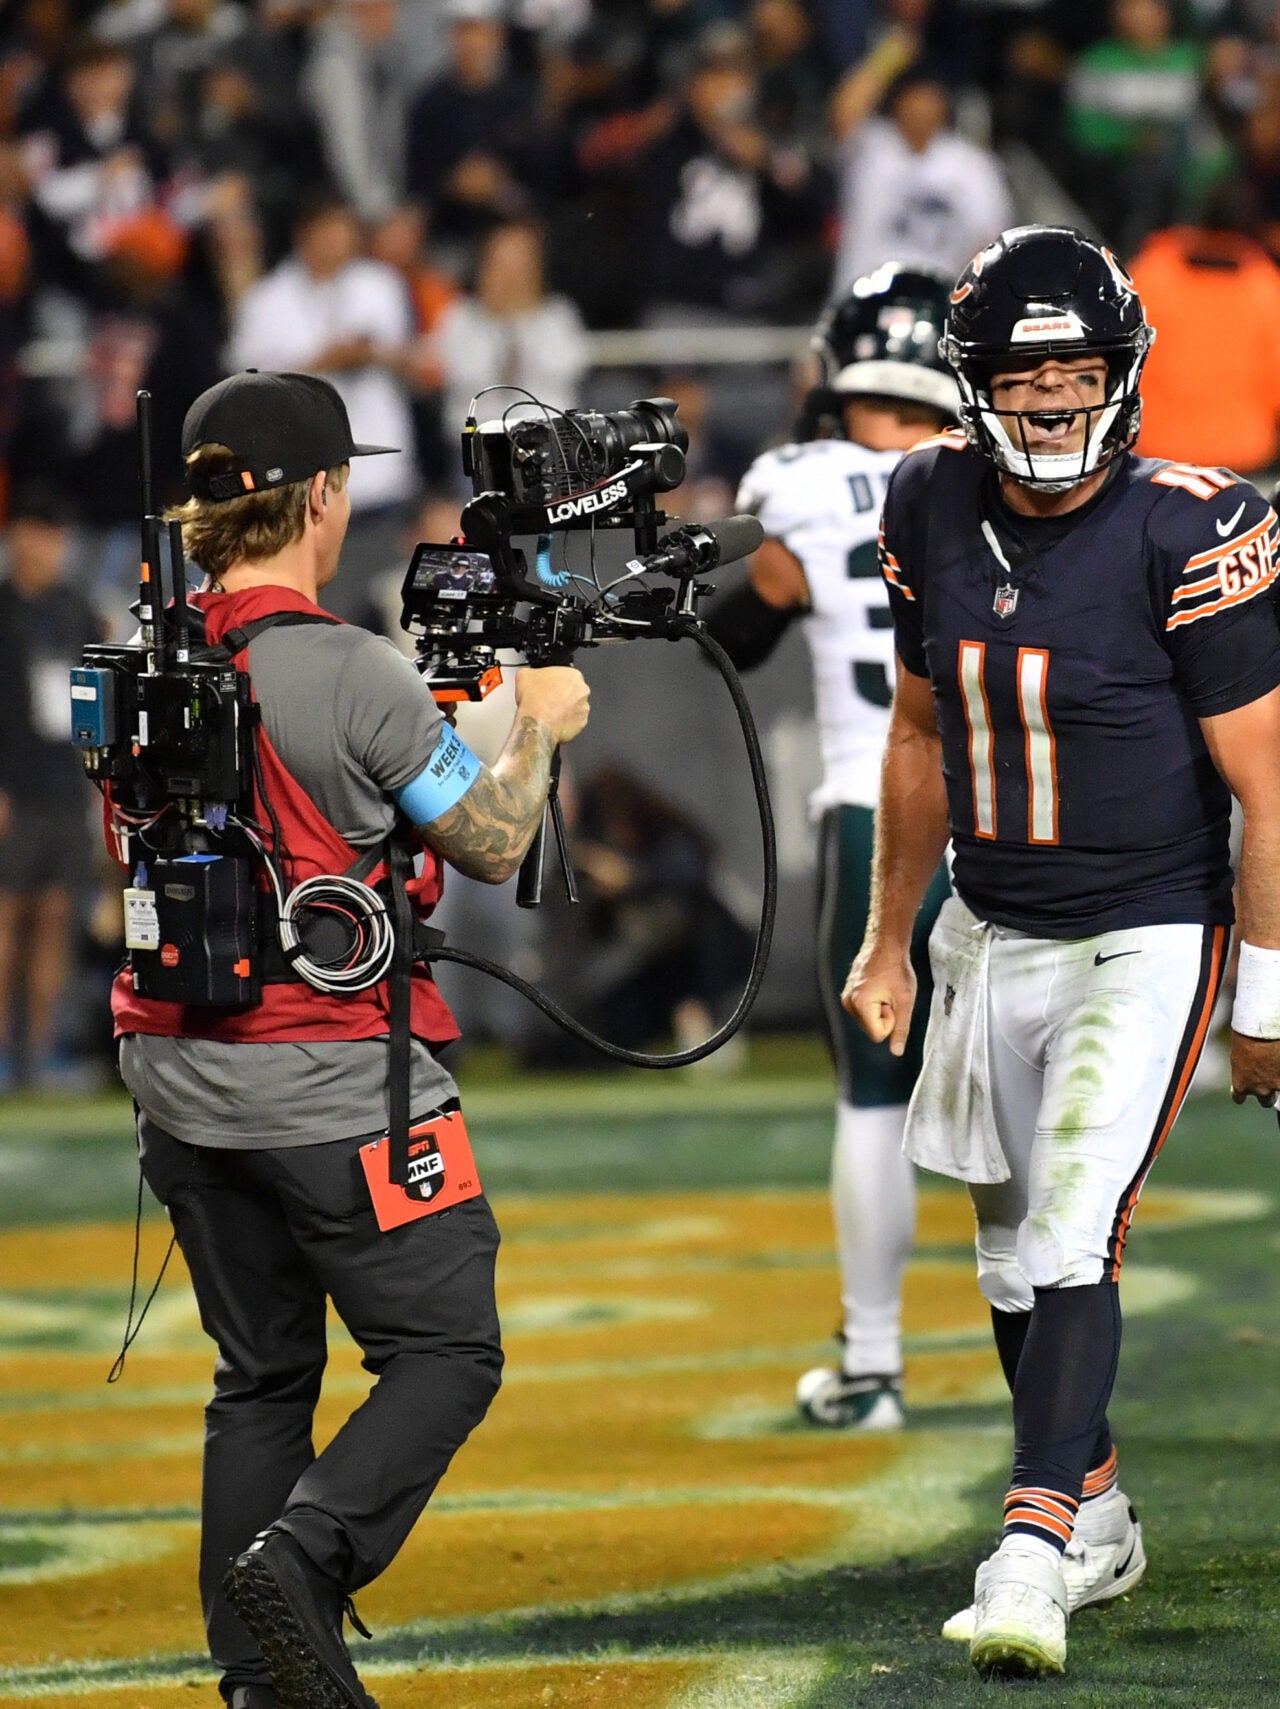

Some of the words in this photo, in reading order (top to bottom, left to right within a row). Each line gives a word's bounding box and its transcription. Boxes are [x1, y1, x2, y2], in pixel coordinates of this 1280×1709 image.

[1022, 321, 1071, 333] BEARS
[546, 480, 628, 525] LOVELESS
[1150, 463, 1238, 502] 11
[1217, 531, 1273, 597] GSH
[430, 740, 460, 778] WEEK
[957, 639, 1060, 846] 11
